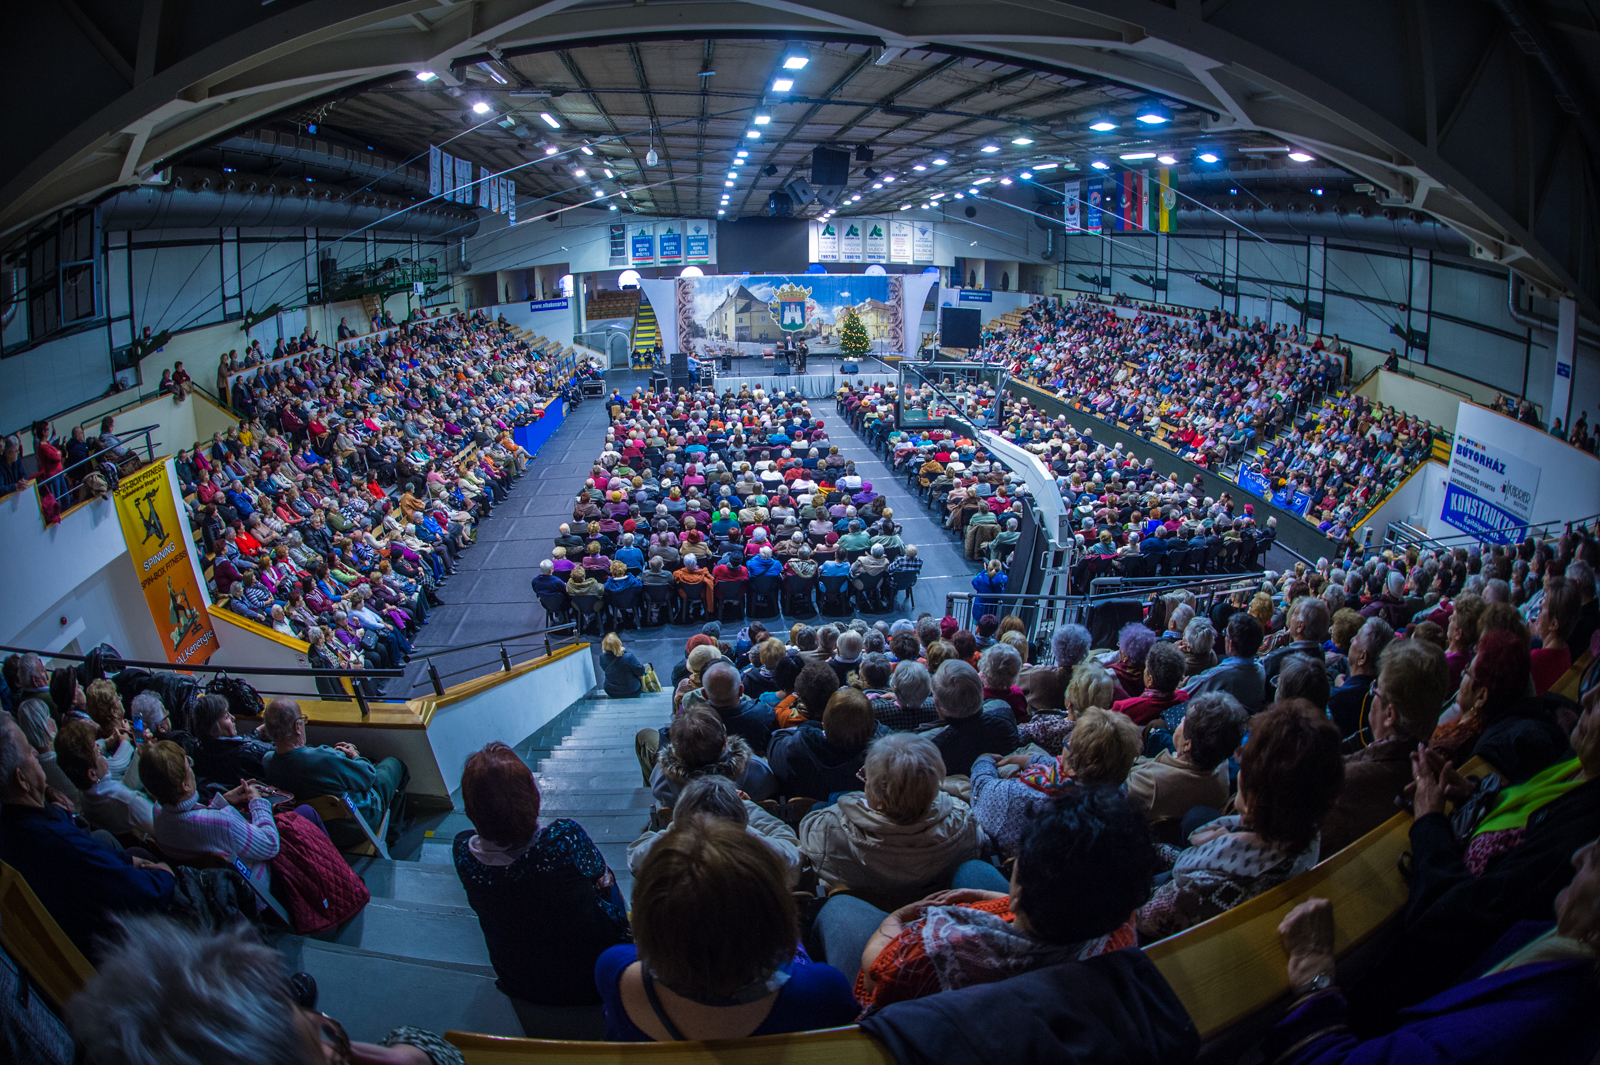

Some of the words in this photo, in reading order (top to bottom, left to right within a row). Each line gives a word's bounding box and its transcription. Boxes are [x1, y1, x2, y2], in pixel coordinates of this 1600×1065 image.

[1458, 435, 1486, 451] PARTNER
[143, 462, 165, 480] FITNESS
[1456, 444, 1506, 475] BÚTORHÁZ
[1450, 493, 1521, 544] KONSTRUKTOR
[141, 566, 166, 590] SPIN-BOX
[166, 550, 187, 571] FITNESS
[143, 541, 175, 572] SPINNING
